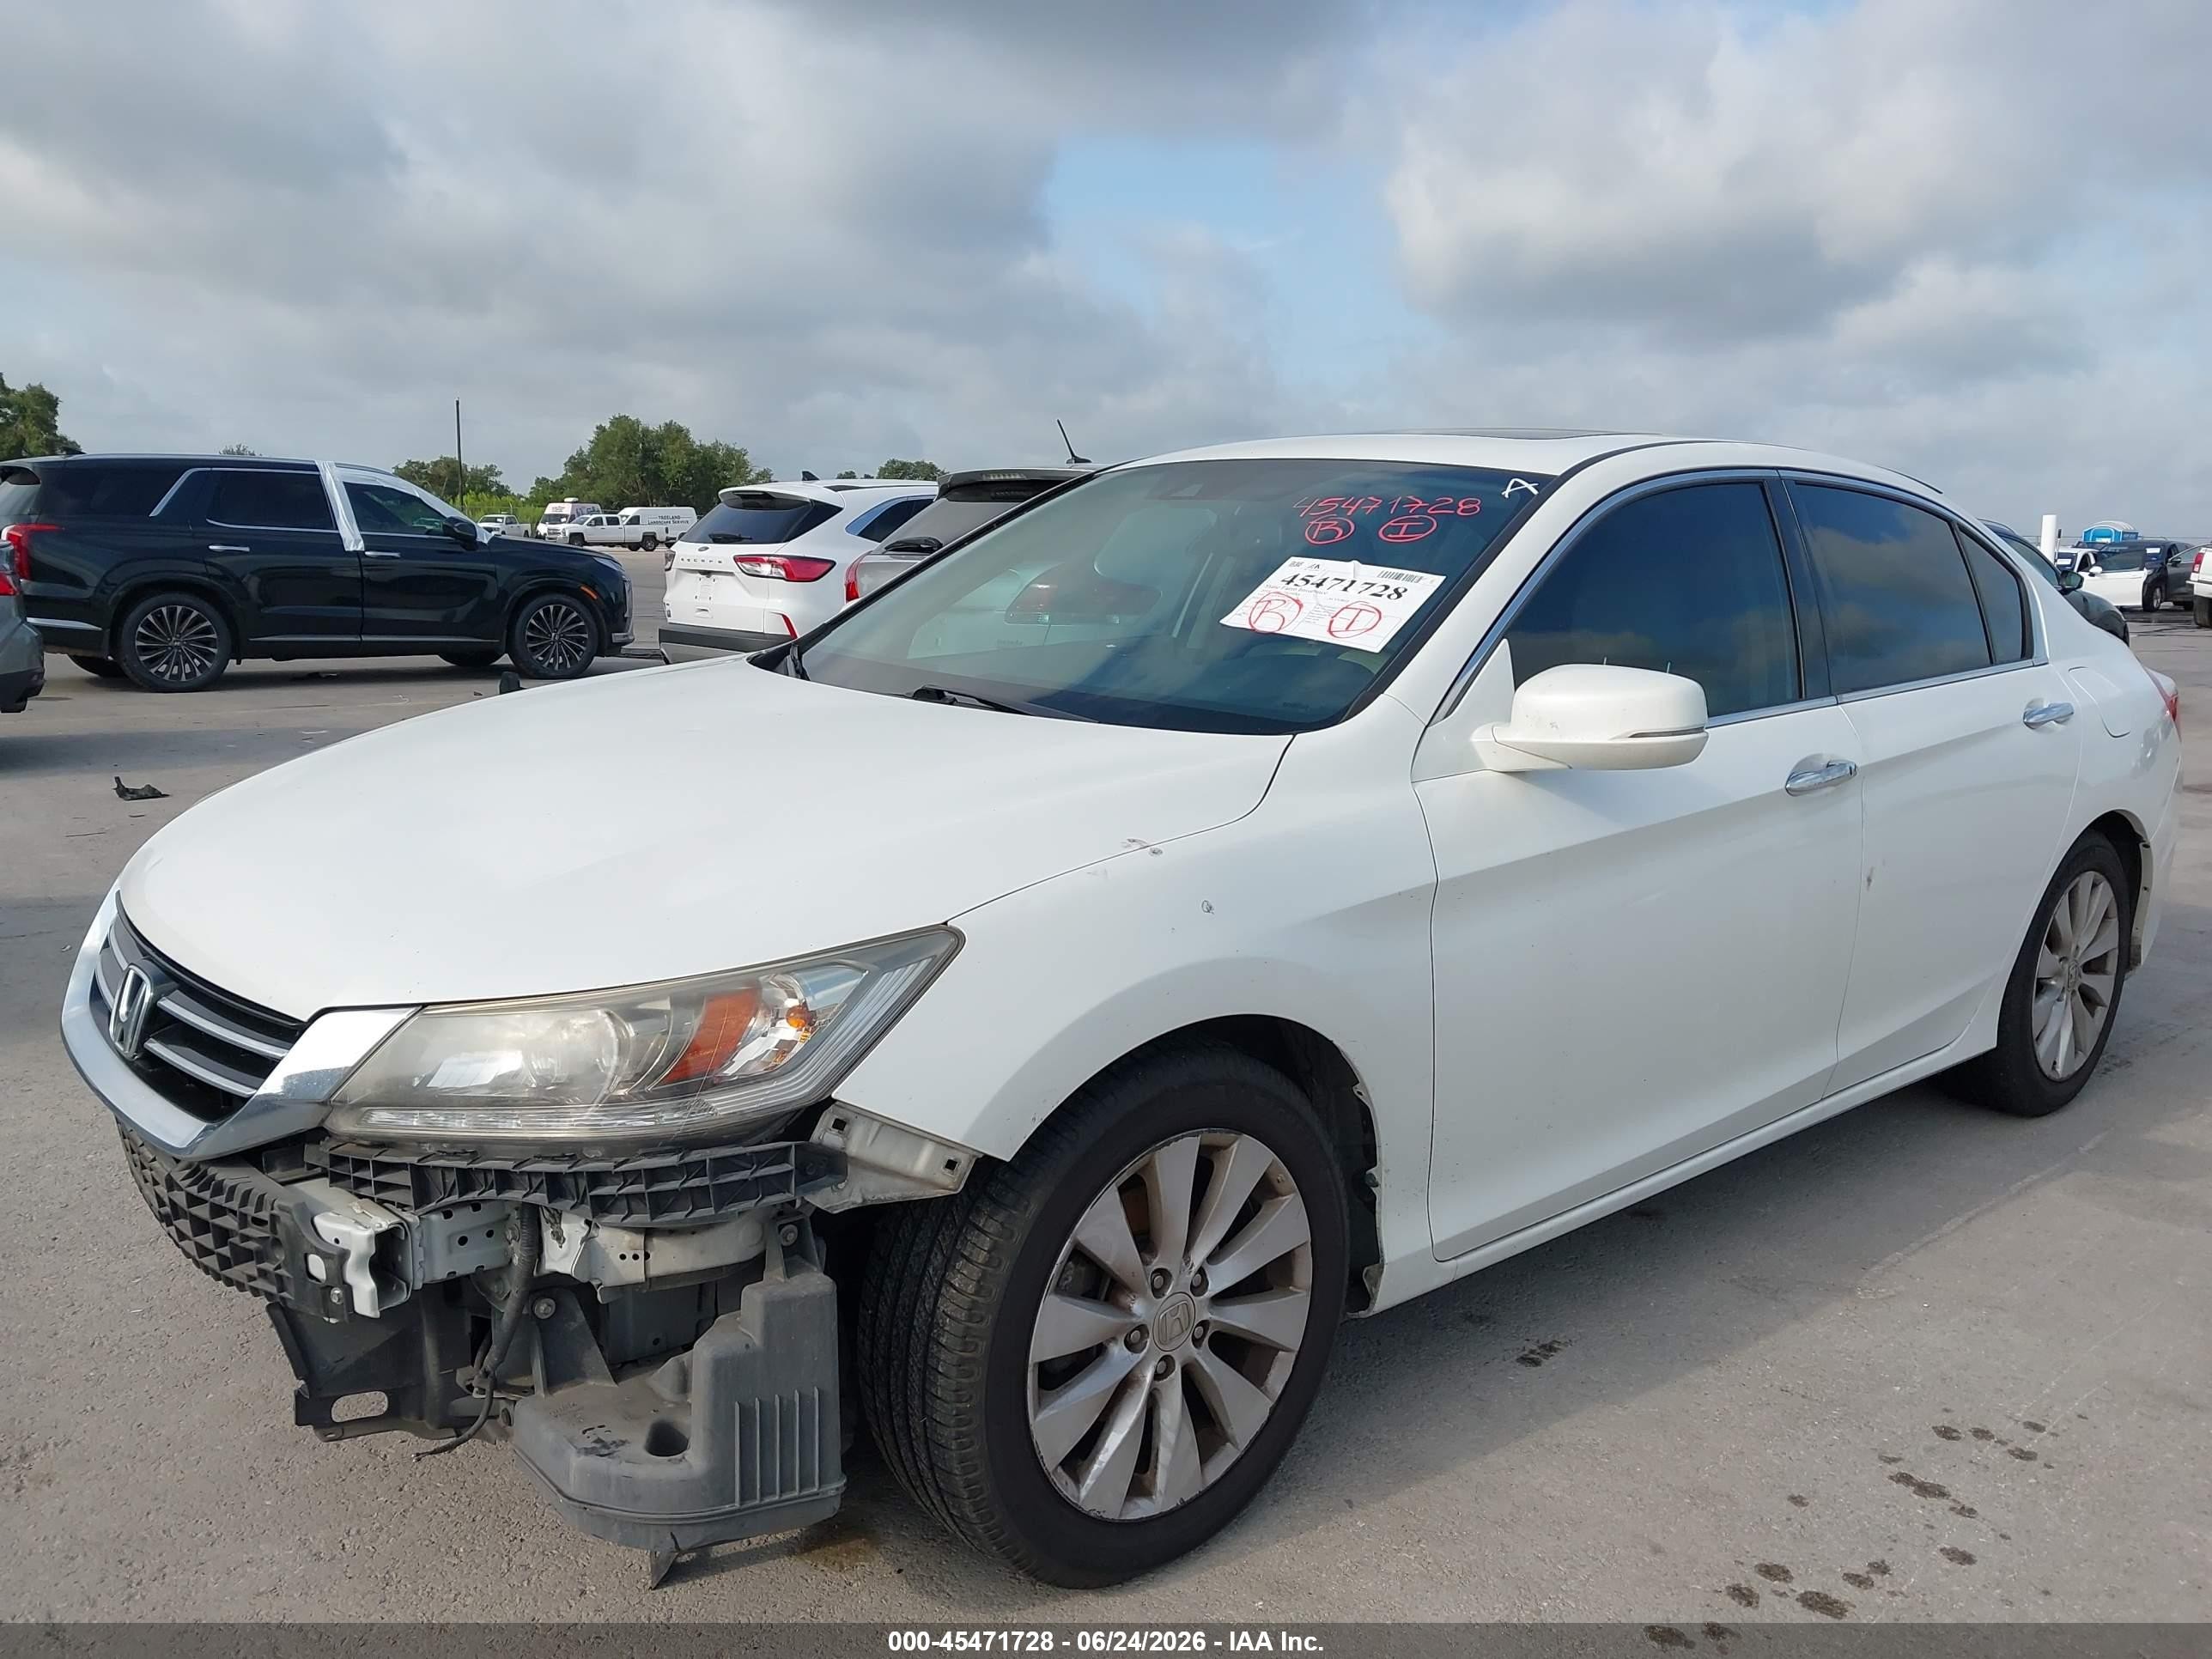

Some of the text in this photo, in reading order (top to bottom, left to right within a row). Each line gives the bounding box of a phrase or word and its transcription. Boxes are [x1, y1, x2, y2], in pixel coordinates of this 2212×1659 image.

[1501, 477, 1540, 498] A
[1292, 496, 1482, 517] 45471728
[1280, 573, 1408, 601] 45471728
